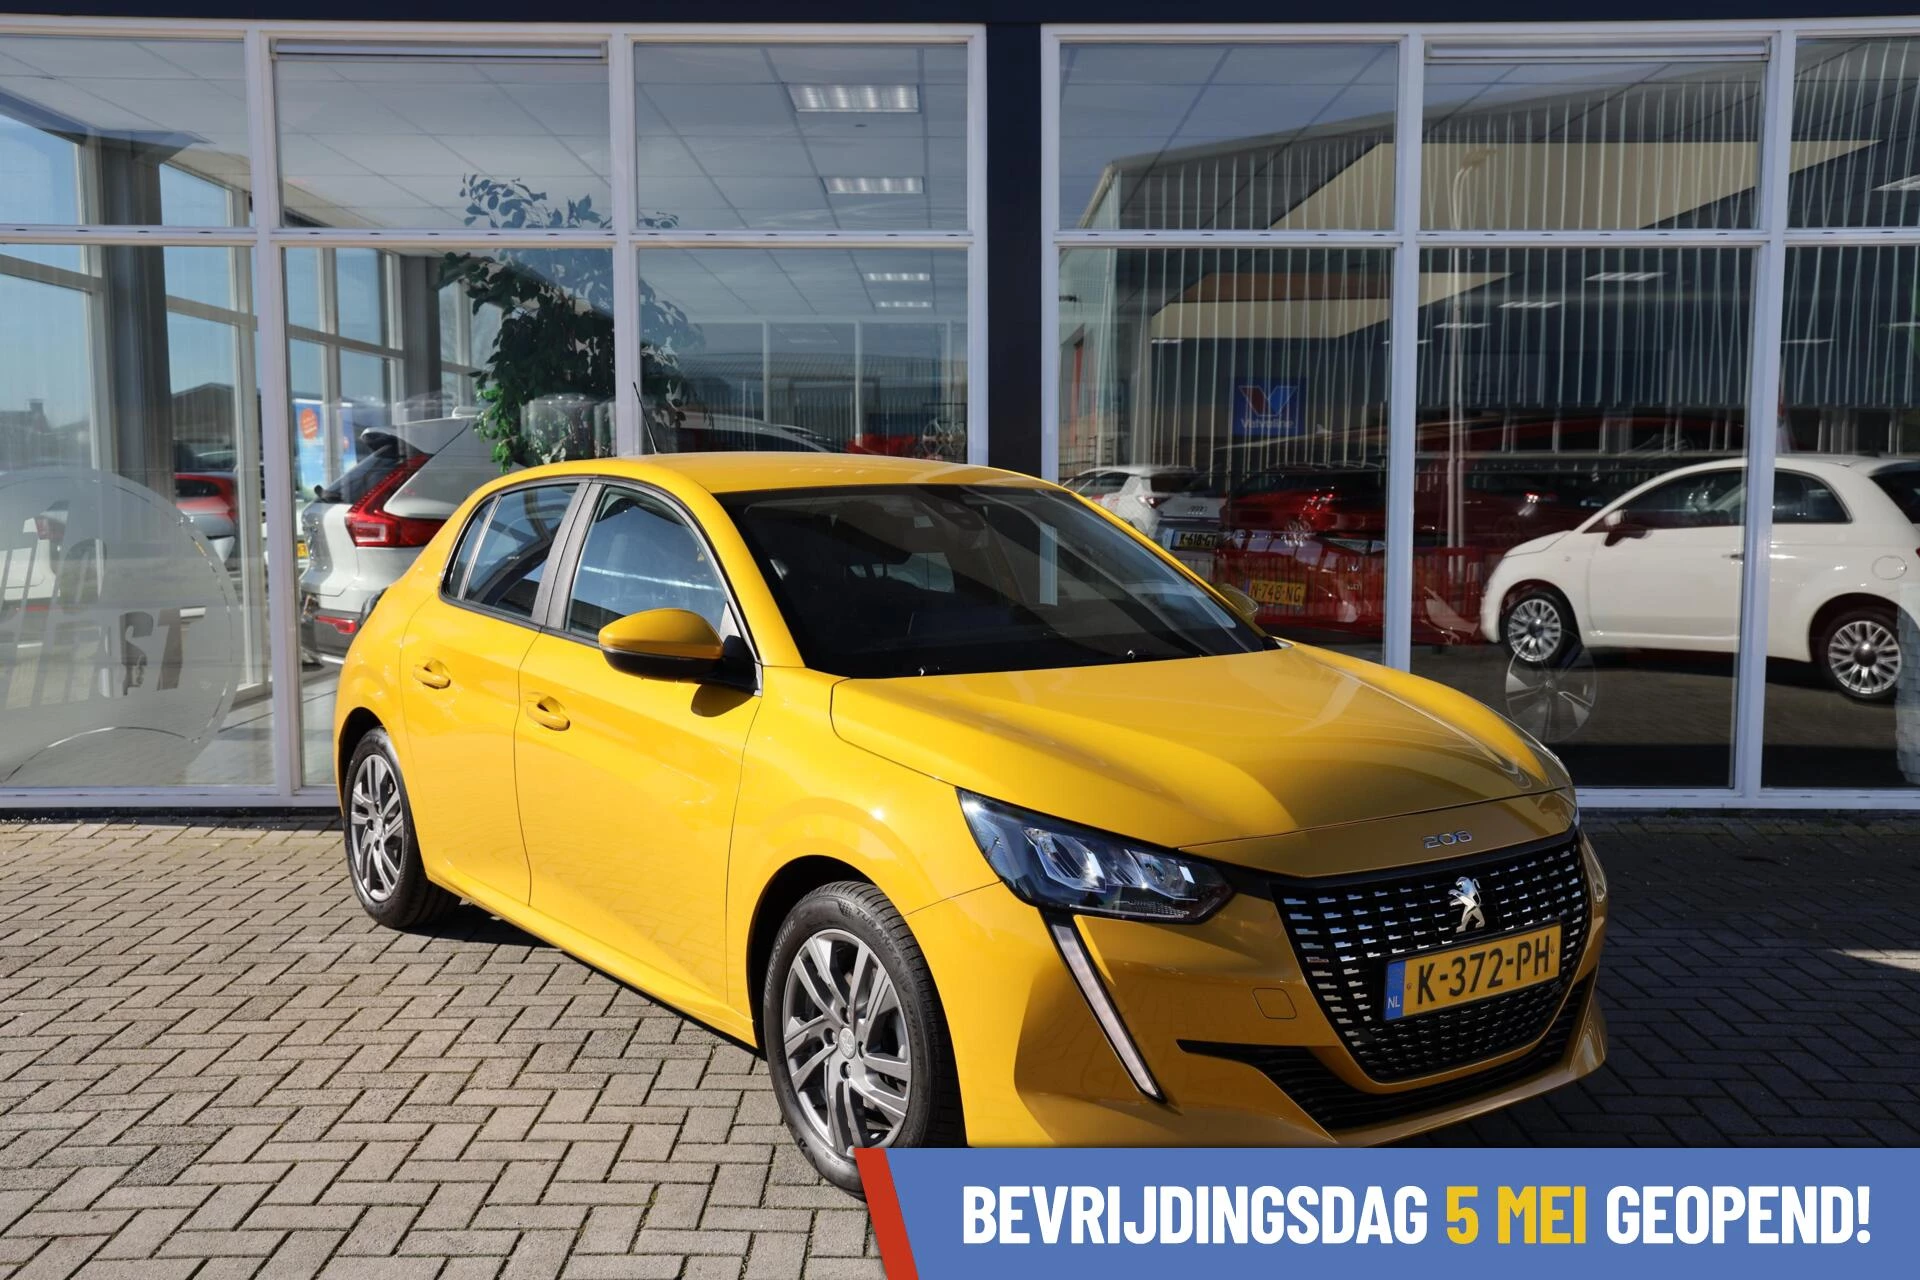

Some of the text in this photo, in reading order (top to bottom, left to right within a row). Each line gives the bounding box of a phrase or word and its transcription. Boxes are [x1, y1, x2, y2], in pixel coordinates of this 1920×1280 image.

[1249, 580, 1301, 604] N-748-NG
[1423, 830, 1472, 849] 208
[1417, 934, 1549, 1005] K-372-PH
[1387, 997, 1401, 1010] NL
